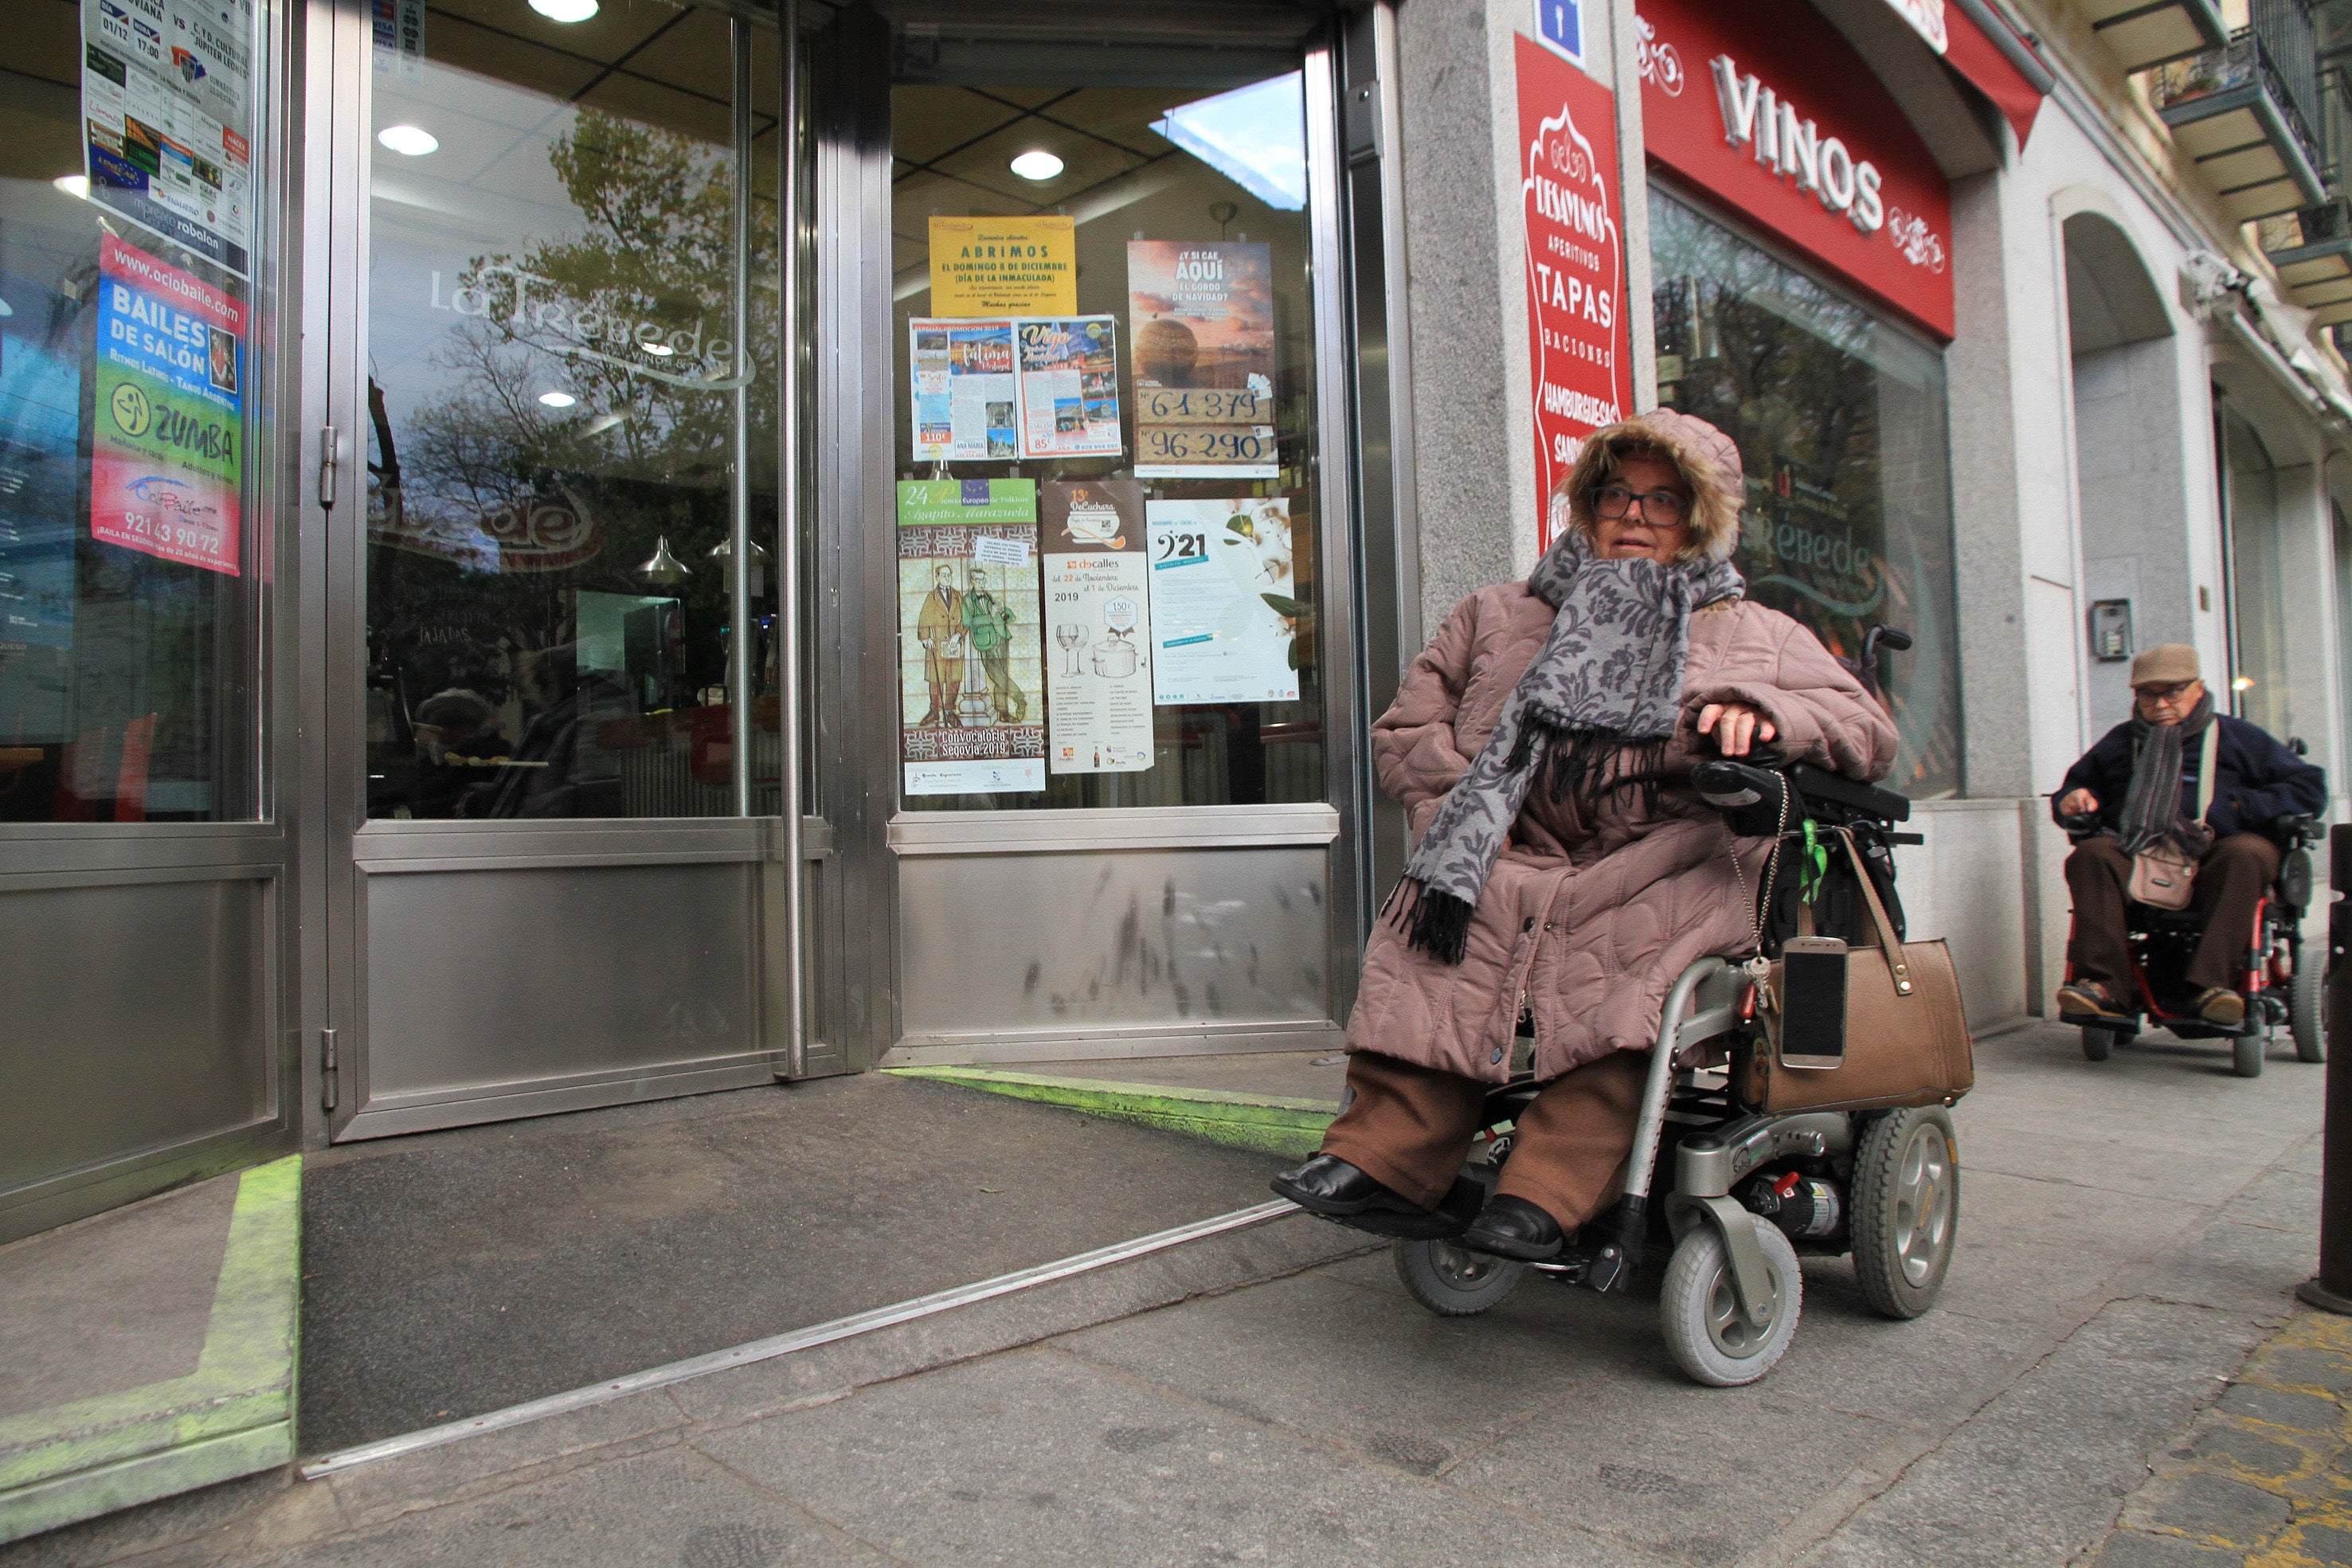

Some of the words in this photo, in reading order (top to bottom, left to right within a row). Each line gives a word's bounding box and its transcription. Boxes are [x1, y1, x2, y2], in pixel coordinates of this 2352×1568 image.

[103, 17, 128, 41] 01/12
[173, 14, 186, 31] VS
[137, 38, 159, 61] 17:00
[1708, 53, 1884, 233] VINOS
[1535, 174, 1606, 244] DESAYUNOS
[961, 245, 1049, 259] ABRIMOS
[1201, 251, 1219, 260] CAE
[1548, 233, 1600, 272] APERITIVOS
[942, 263, 951, 272] EL
[1021, 262, 1067, 271] DICIEMBRE
[1175, 260, 1223, 282] AQUÍ
[114, 248, 239, 323] www.ociobaile.com
[1536, 263, 1612, 329] TAPAS
[1186, 292, 1228, 302] NAVIDAD?
[113, 283, 206, 348] BAILES
[110, 318, 139, 347] DE
[143, 332, 205, 376] SALÓN
[1022, 324, 1072, 353] Vigo
[1544, 327, 1611, 369] RACIONES
[155, 404, 234, 467] ZUMBA
[905, 486, 929, 506] 24
[1070, 501, 1116, 511] DeCuchara
[125, 511, 151, 537] 921
[175, 527, 197, 549] 90
[200, 533, 220, 555] 72
[1051, 574, 1061, 583] del
[1082, 573, 1119, 583] Noviembre
[1106, 583, 1140, 592] Diciembre
[1055, 592, 1079, 602] 2019
[941, 729, 1006, 744] Convocatoria
[942, 744, 980, 757] Segovia
[983, 743, 1006, 754] 2019
